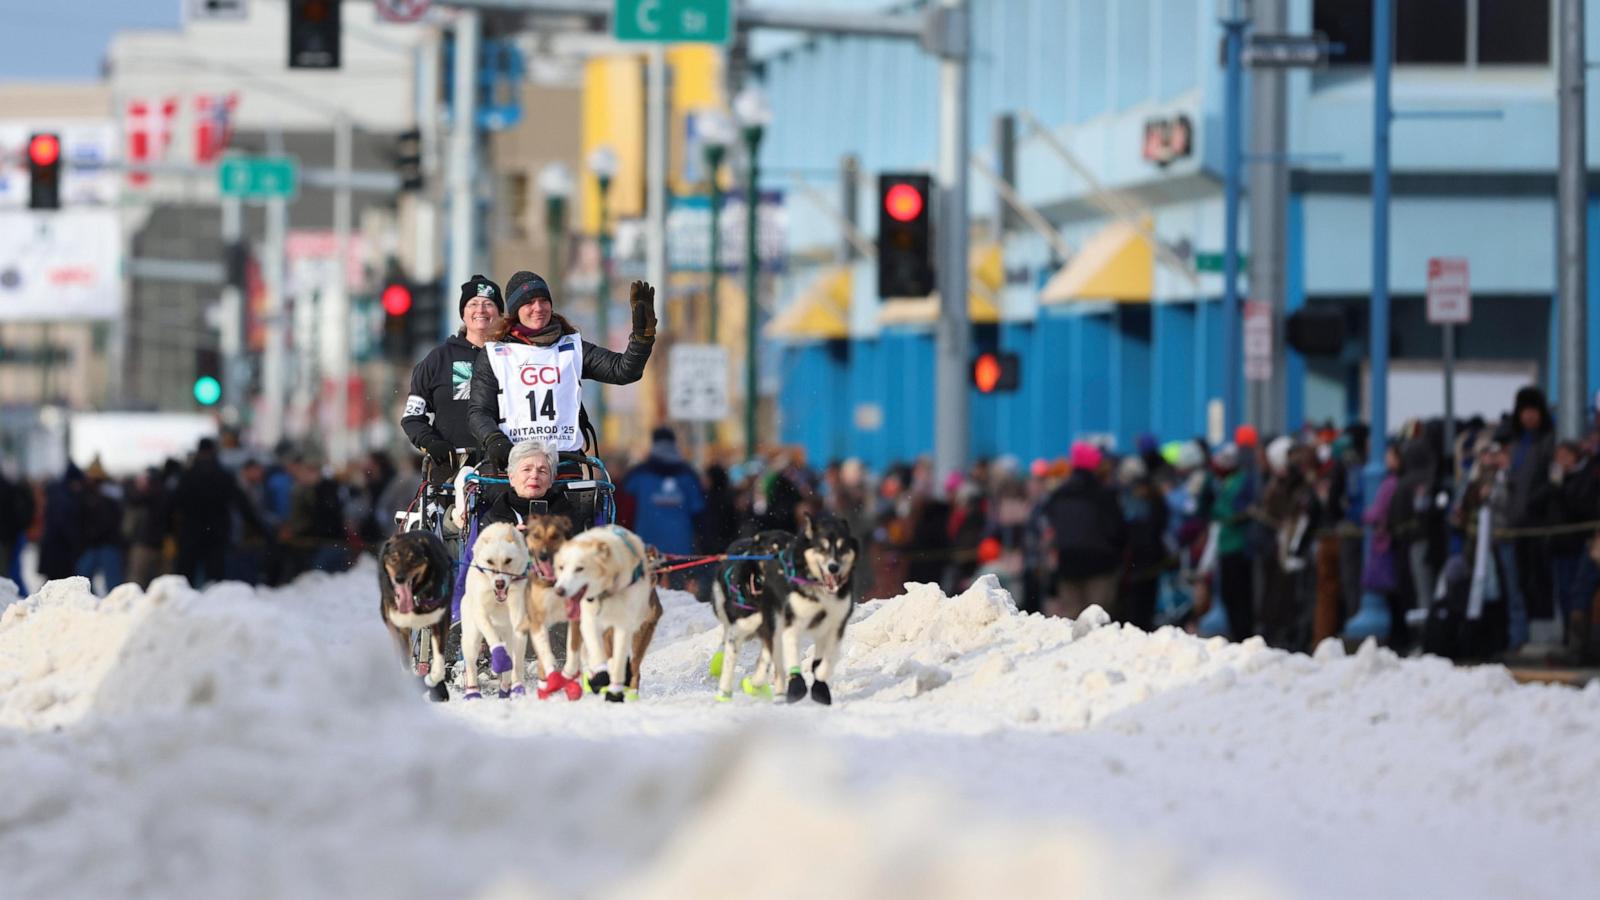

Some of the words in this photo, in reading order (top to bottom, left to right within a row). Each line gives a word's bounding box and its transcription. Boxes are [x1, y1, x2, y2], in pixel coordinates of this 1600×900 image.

[636, 0, 660, 34] C
[520, 366, 561, 386] GCI
[525, 388, 556, 422] 14
[509, 425, 558, 436] IDITAROD
[561, 425, 575, 434] '25
